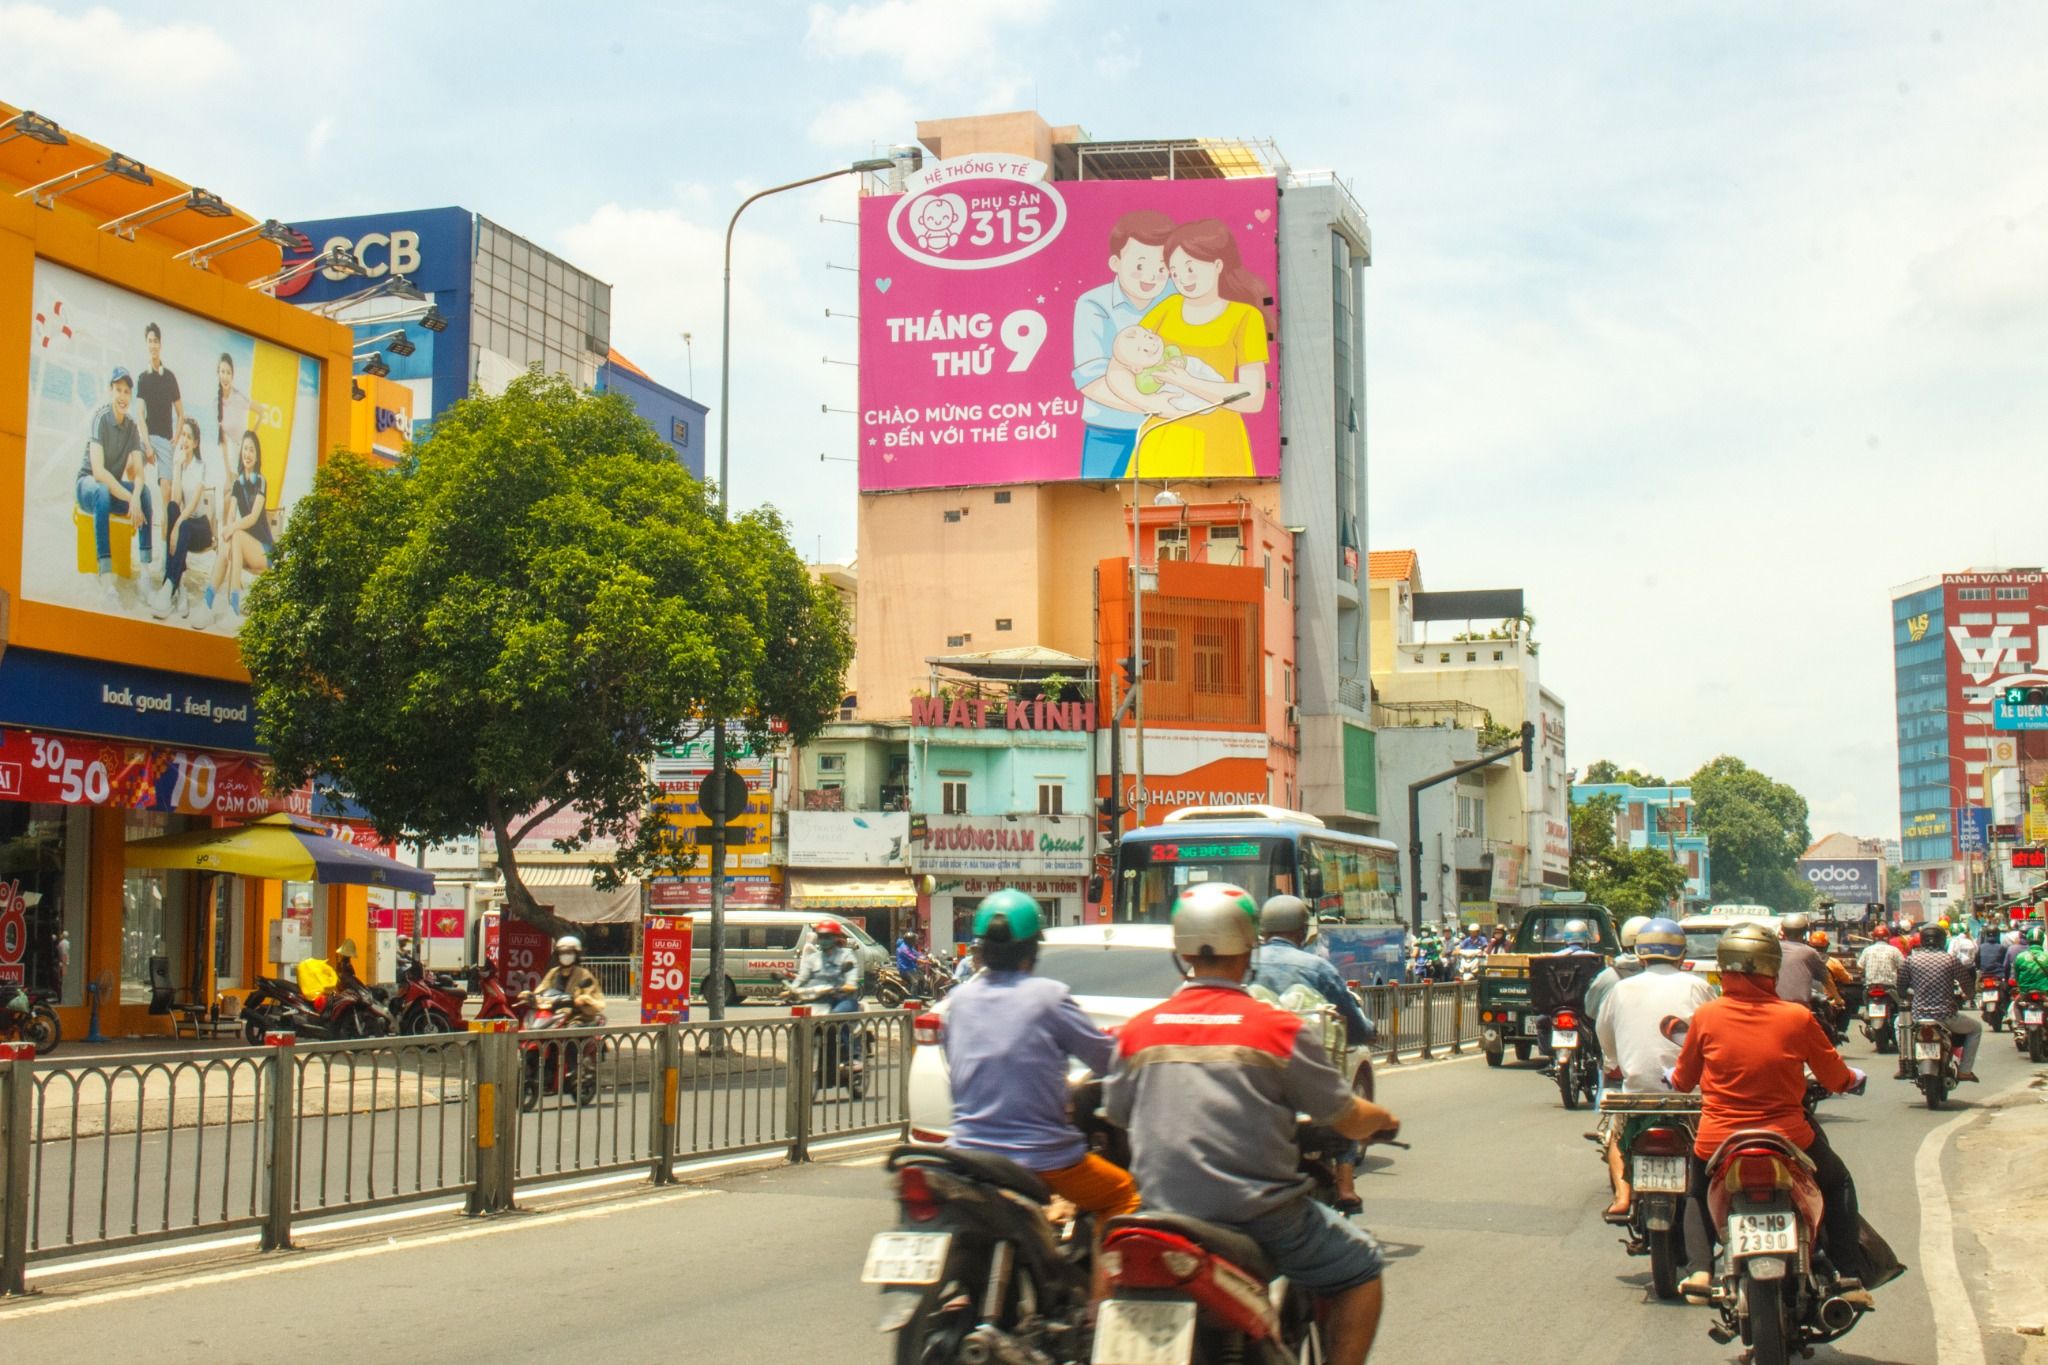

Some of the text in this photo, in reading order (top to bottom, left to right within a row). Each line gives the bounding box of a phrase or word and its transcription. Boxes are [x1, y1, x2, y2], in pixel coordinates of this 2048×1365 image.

[924, 160, 1031, 185] HỆ THỐNG Y TẾ
[971, 190, 1041, 212] PHỤ SẢN
[970, 207, 1042, 246] 315
[322, 230, 422, 281] SCB
[886, 309, 993, 343] THÁNG
[1000, 309, 1048, 373] 9
[932, 344, 995, 377] THỨ
[864, 396, 1078, 425] CHÀO MỪNG CON YÊU
[375, 406, 413, 442] yody
[884, 420, 1057, 447] ĐẾN VỚI THẾ GIỚI
[1944, 575, 1977, 584] ANH
[103, 684, 133, 706] look
[136, 694, 172, 713] good
[184, 696, 210, 717] feel
[213, 705, 247, 723] good
[2008, 688, 2021, 703] 24
[1007, 693, 1095, 732] KÍNH
[2001, 703, 2015, 719] XE
[31, 737, 64, 769] 30
[171, 752, 216, 809] 10
[216, 791, 244, 812] CẢM
[1152, 789, 1265, 806] HAPPY MONEY
[923, 824, 994, 851] PHƯƠNG
[996, 829, 1034, 851] NAM
[1152, 844, 1178, 861] 32
[1808, 865, 1860, 882] odoo
[965, 878, 983, 895] CẬN
[652, 918, 665, 929] 10
[508, 949, 533, 968] 30
[652, 951, 676, 967] 30
[748, 961, 795, 969] MIKADO
[649, 968, 684, 991] 50
[1740, 1233, 1788, 1253] 2390
